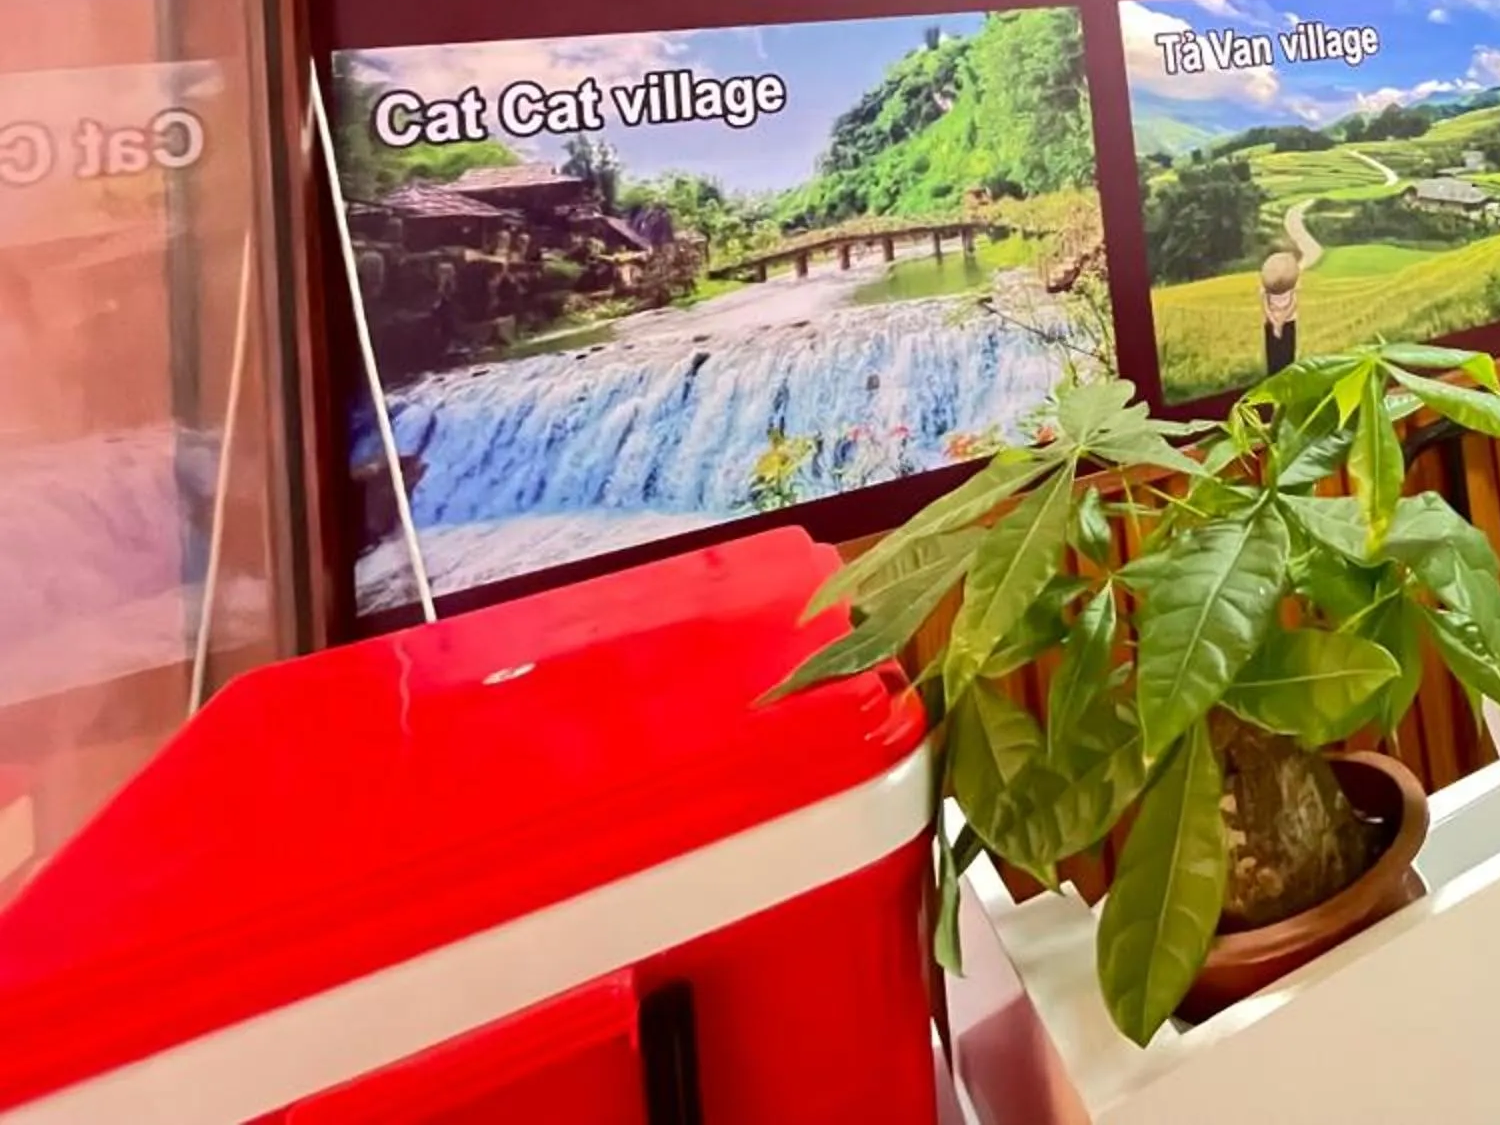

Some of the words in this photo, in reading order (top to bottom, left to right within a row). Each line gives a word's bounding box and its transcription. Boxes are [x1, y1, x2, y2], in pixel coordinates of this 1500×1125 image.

[1206, 29, 1274, 70] Van
[1277, 22, 1381, 66] village
[373, 87, 490, 148] Cat
[498, 76, 604, 137] Cat
[611, 69, 788, 129] village
